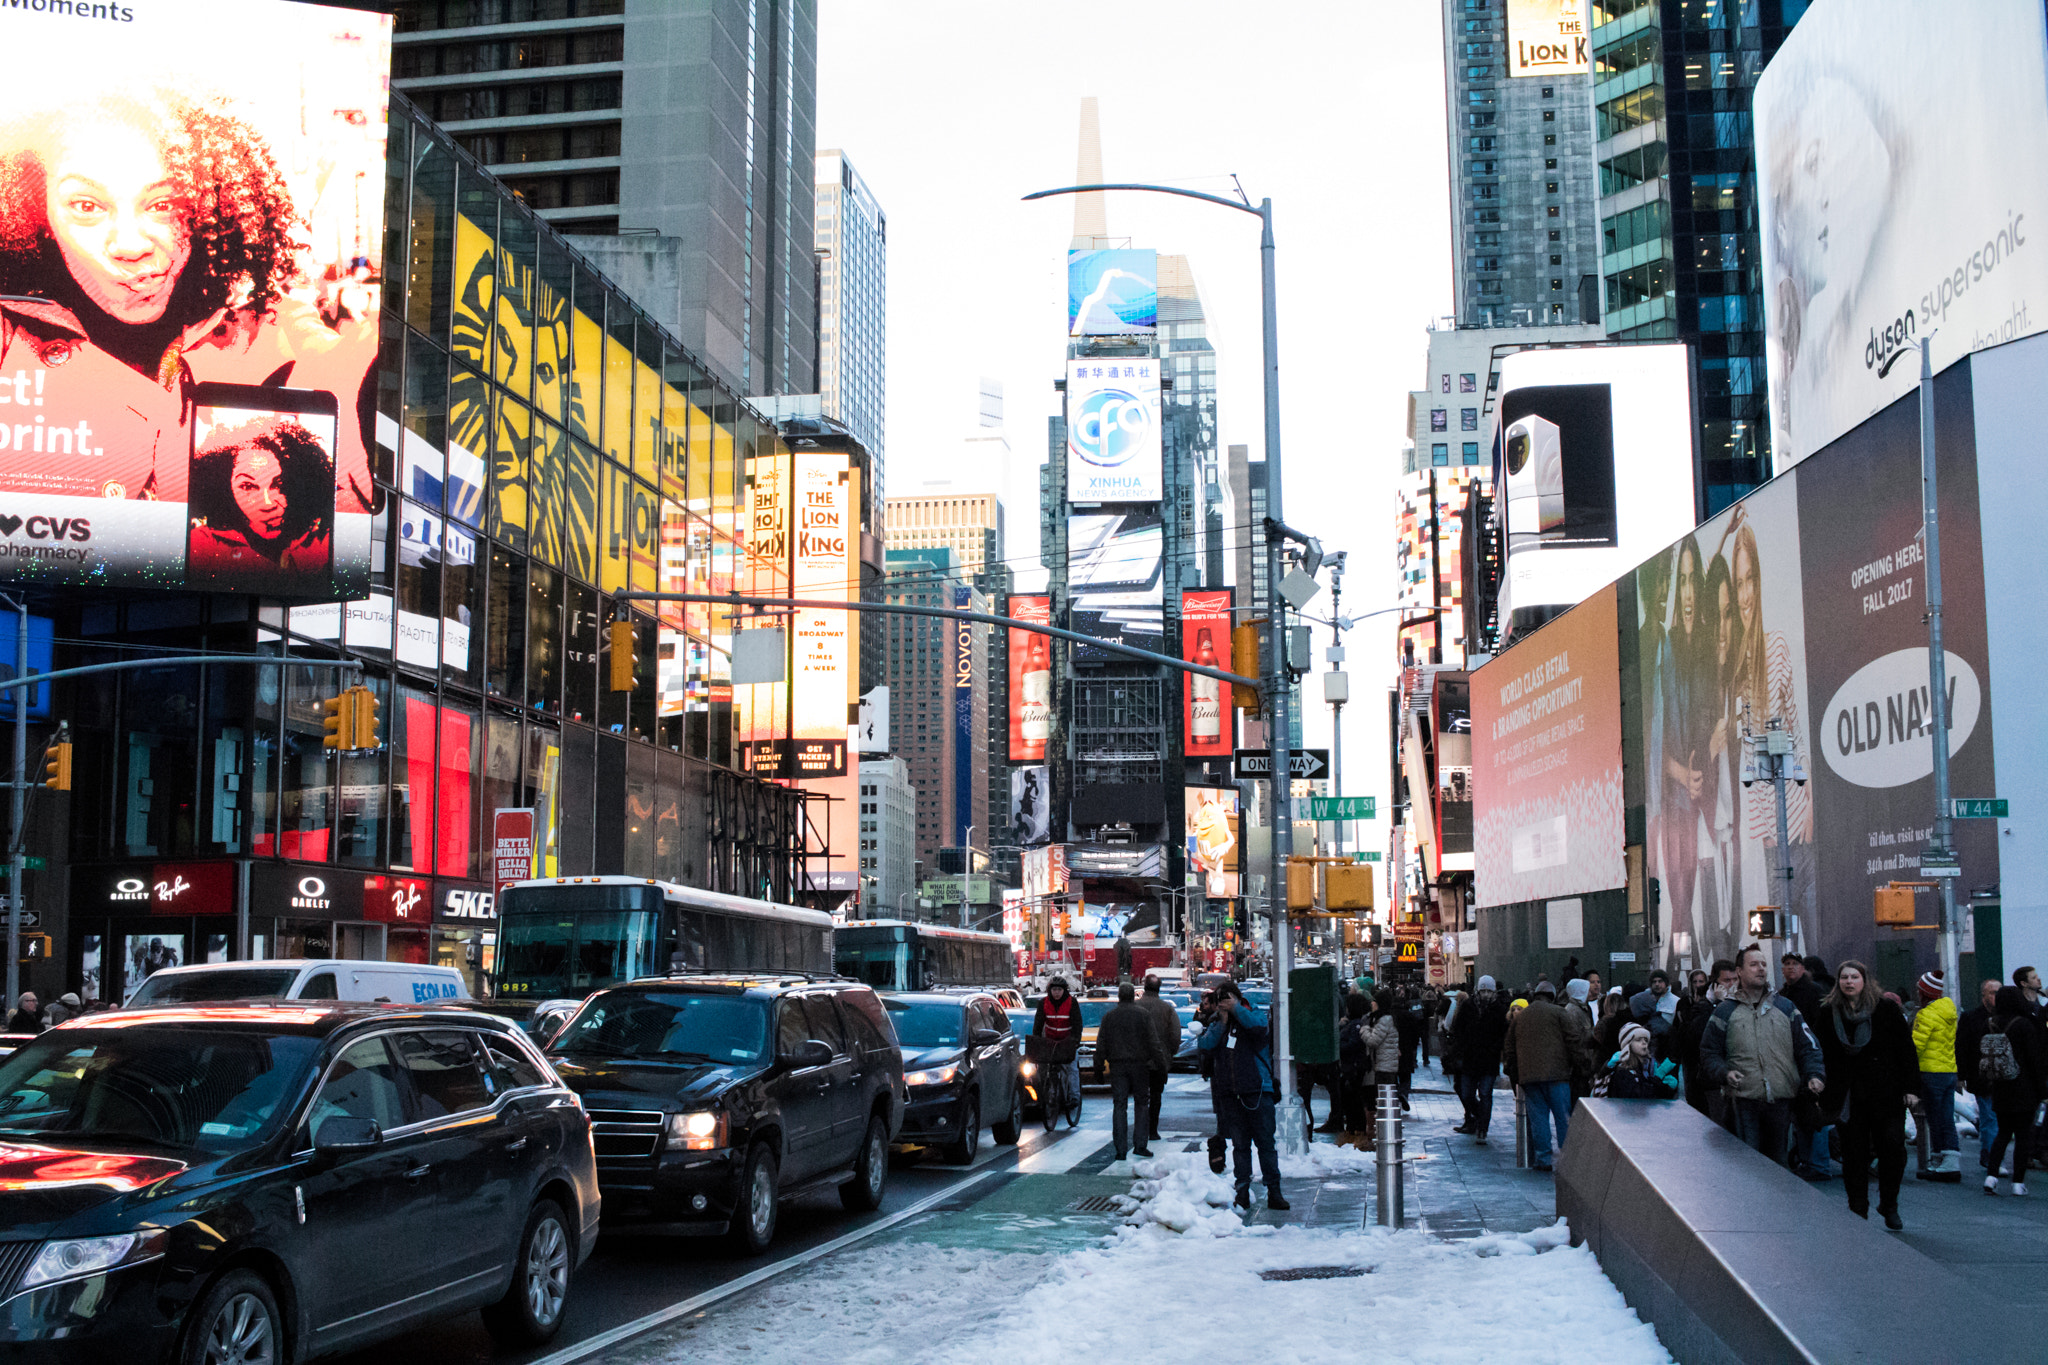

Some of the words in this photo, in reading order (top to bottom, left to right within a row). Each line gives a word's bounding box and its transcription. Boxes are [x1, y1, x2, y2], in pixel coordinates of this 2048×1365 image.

[1558, 21, 1581, 32] THE
[1518, 40, 1568, 67] LION
[1865, 309, 1915, 376] dyson
[1920, 209, 2026, 325] supersonic
[1076, 366, 1151, 379] 新华通讯社
[1088, 477, 1142, 488] XINHUA
[806, 491, 833, 504] THE
[1077, 489, 1108, 498] NEWS
[1110, 488, 1154, 498] AGENCY
[802, 507, 839, 529] LION
[25, 515, 91, 542] CVS
[799, 531, 845, 557] KING
[1852, 555, 1893, 590] OPENING
[1895, 542, 1924, 571] HERE
[1863, 590, 1886, 615] FALL
[1888, 577, 1913, 606] 2017
[817, 642, 824, 650] 8
[956, 598, 971, 688] NOVOTL
[1500, 677, 1523, 707] WORLD
[1523, 664, 1545, 694] CLASS
[1545, 650, 1570, 684] RETAIL
[1498, 703, 1531, 738] BRANDING
[1532, 675, 1583, 720] OPPORTUNITY
[1837, 701, 1882, 757] OLD
[806, 745, 824, 753] GET
[797, 753, 832, 761] TICKETS
[802, 762, 827, 770] HERE!
[1248, 758, 1271, 770] ONE
[1290, 758, 1315, 770] WAY
[1314, 800, 1328, 818] W
[1336, 799, 1356, 817] 44
[1363, 798, 1374, 810] St
[1957, 801, 1968, 816] W
[1973, 801, 1991, 816] 44
[1915, 828, 1925, 841] us
[497, 837, 530, 848] BETTE
[495, 847, 531, 857] MIDLER
[1363, 852, 1373, 860] 44
[498, 858, 529, 869] HELLO,
[1883, 854, 1897, 870] and
[1898, 853, 1921, 869] Broad
[498, 868, 529, 879] DOLLY!
[110, 892, 149, 900] OAKLEY
[291, 896, 330, 910] OAKLEY
[1214, 950, 1225, 968] tkts
[502, 983, 529, 992] 982
